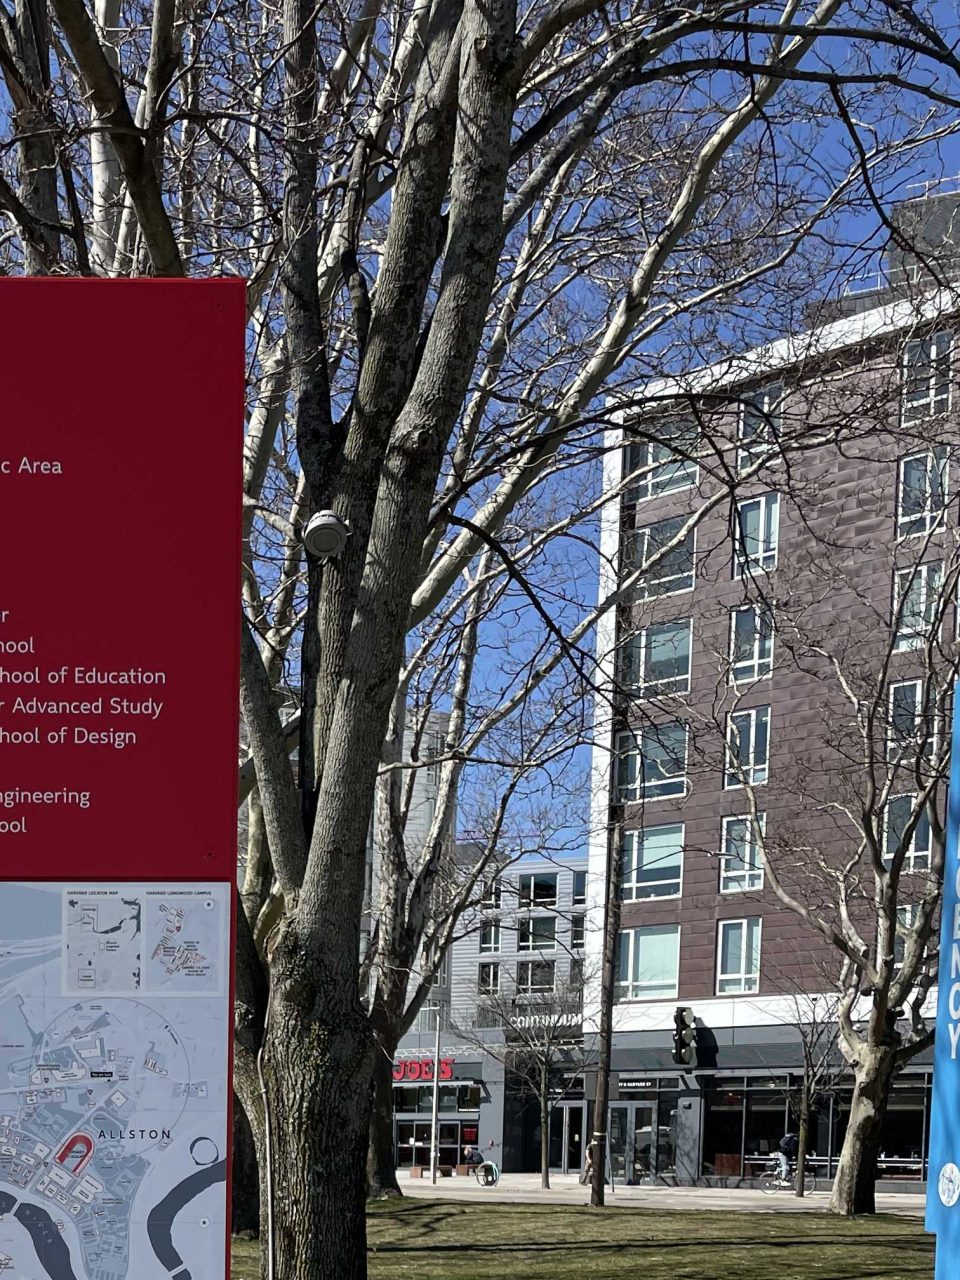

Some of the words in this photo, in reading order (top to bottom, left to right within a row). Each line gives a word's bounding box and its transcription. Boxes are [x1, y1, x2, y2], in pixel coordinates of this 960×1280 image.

[18, 456, 63, 474] Area
[47, 666, 69, 684] of
[74, 667, 166, 685] Education
[11, 696, 102, 714] Advanced
[110, 697, 164, 720] Study
[47, 726, 68, 744] of
[74, 727, 136, 749] Design
[393, 1057, 455, 1081] JOES
[98, 1129, 171, 1140] ALLSTON
